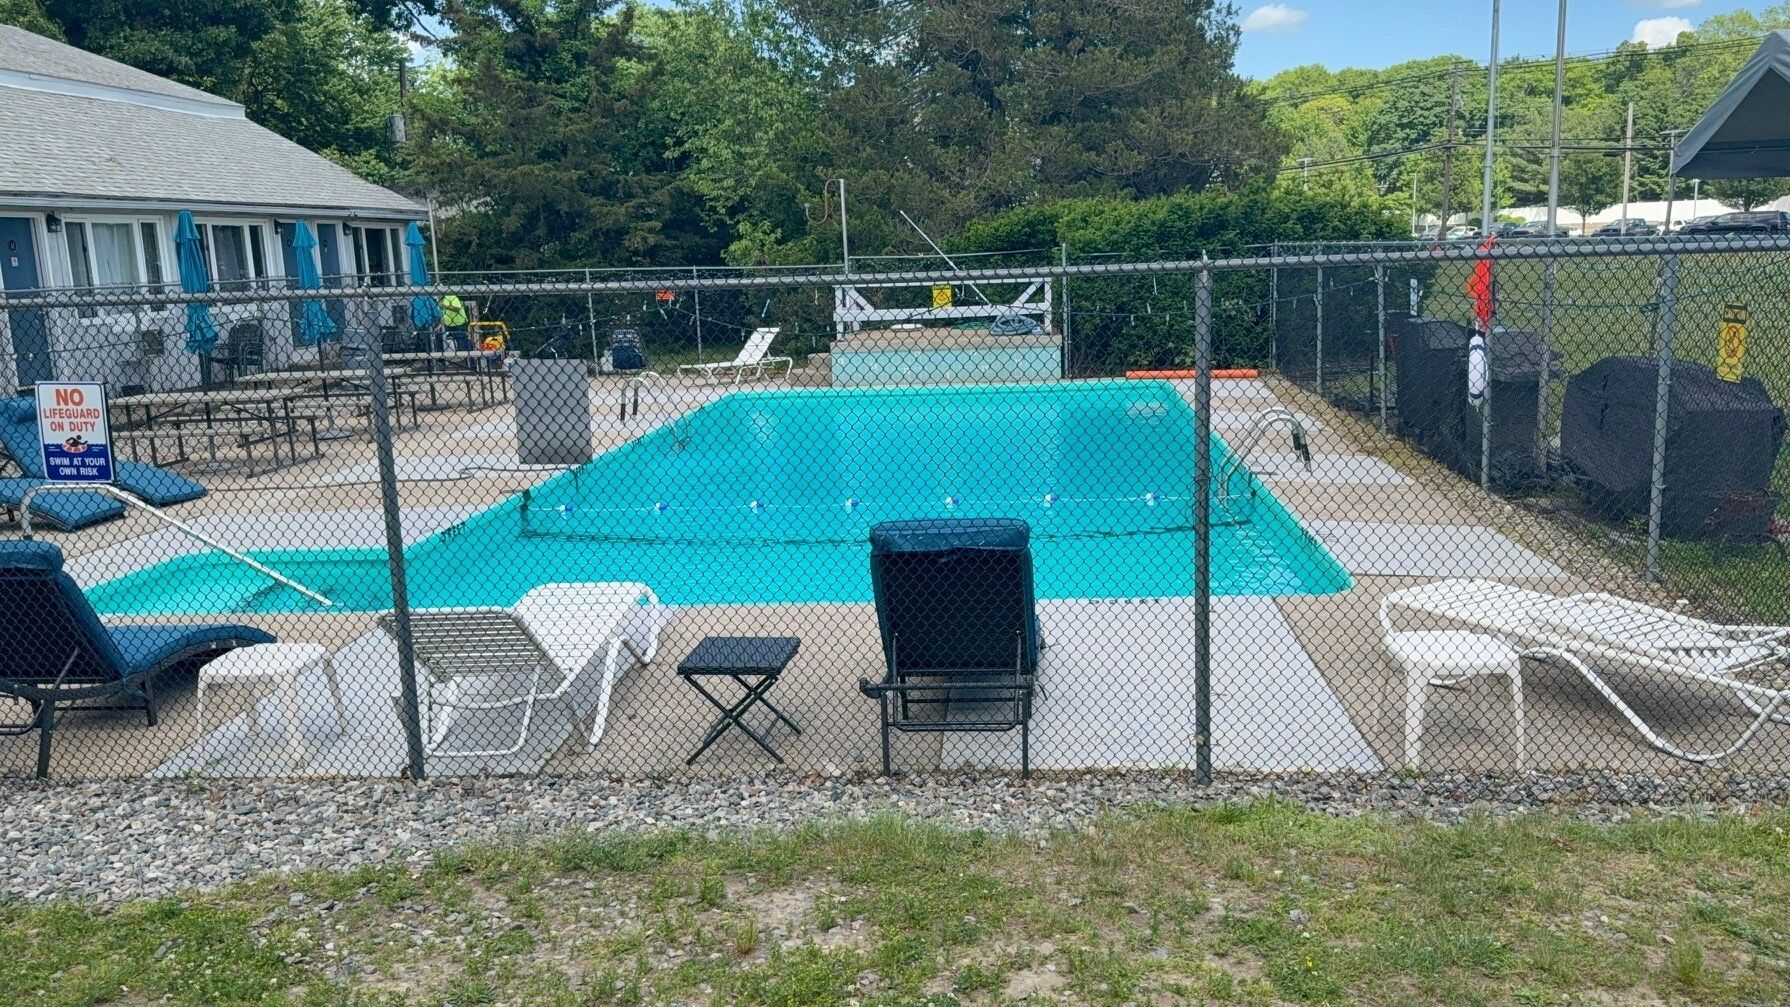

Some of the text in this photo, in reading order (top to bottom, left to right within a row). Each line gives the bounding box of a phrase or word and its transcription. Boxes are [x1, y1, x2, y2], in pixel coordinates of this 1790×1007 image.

[54, 388, 84, 406] NO
[43, 408, 100, 419] LIFEGUARD
[50, 421, 96, 432] ON DUTY
[49, 457, 106, 466] SWIM AT YOUR
[59, 467, 99, 476] OWN RISK
